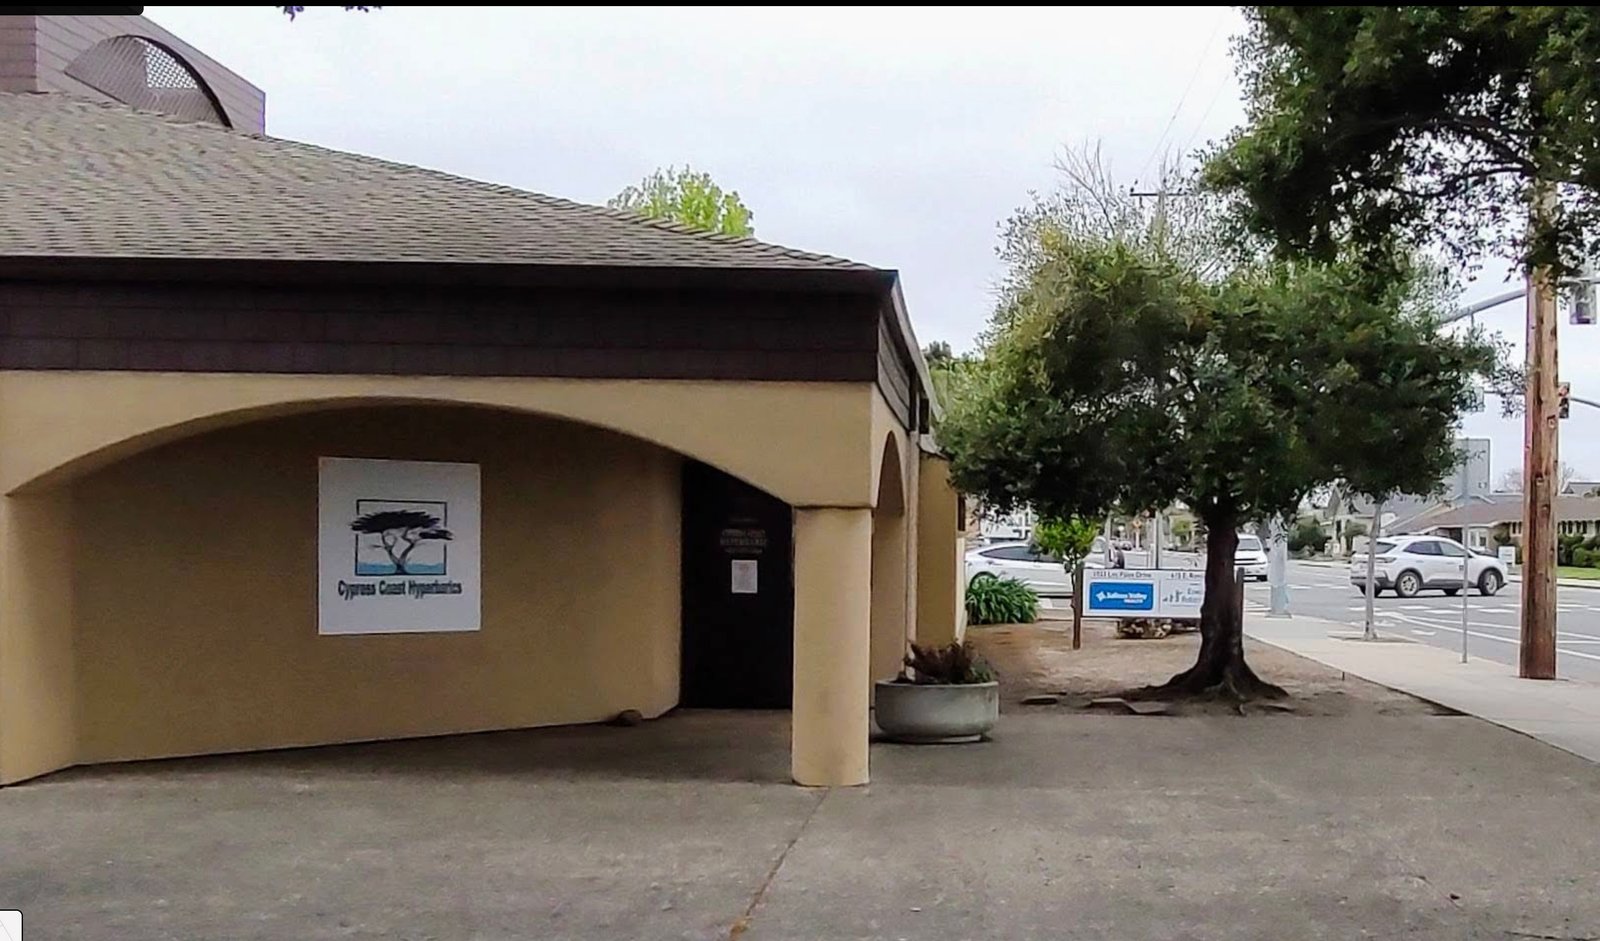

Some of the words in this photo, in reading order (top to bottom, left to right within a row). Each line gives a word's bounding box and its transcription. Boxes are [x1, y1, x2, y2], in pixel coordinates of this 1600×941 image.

[338, 580, 376, 600] Cypress
[379, 580, 406, 595] Coast
[408, 580, 462, 599] Hyperbarics
